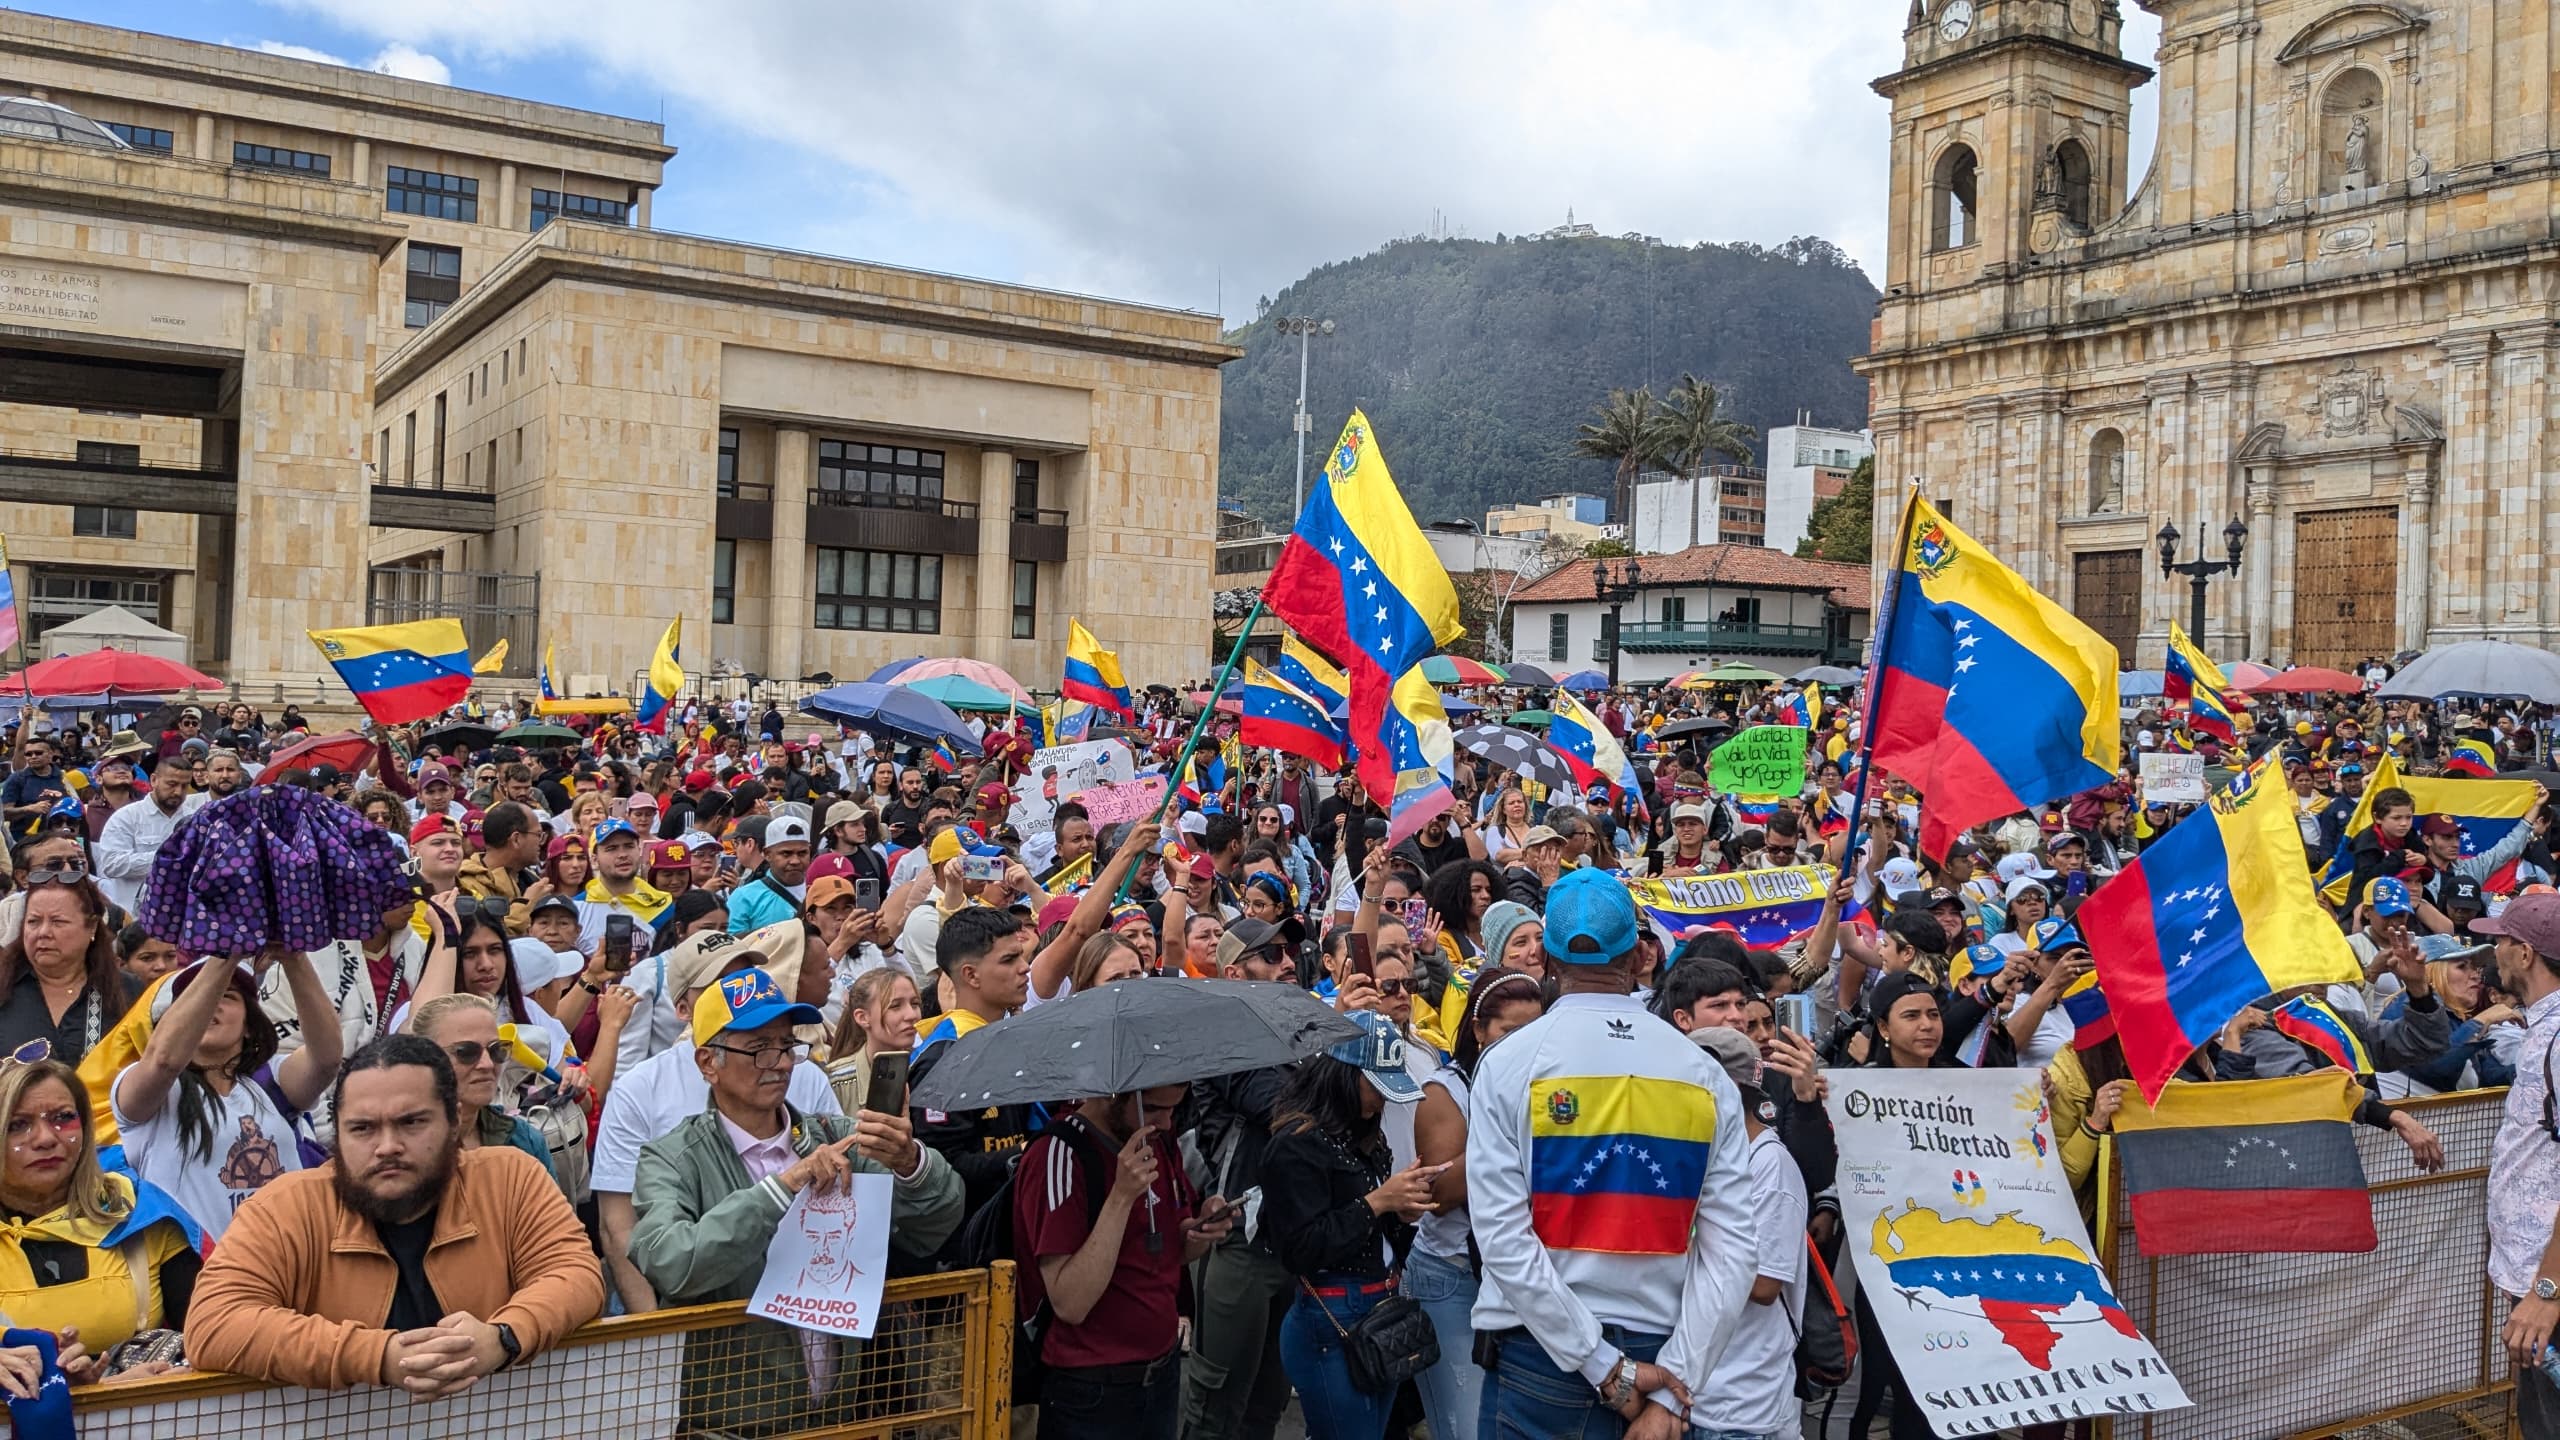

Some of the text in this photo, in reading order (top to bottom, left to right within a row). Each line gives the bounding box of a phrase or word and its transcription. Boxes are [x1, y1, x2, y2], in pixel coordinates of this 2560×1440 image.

[34, 271, 56, 283] LAS
[62, 275, 100, 288] ARMAS
[14, 286, 99, 304] INDEPENDENCIA
[48, 306, 98, 321] LIBERTAD
[1663, 878, 1745, 909] Mano
[1747, 870, 1813, 901] tengo
[390, 967, 403, 991] KARL
[1607, 1032, 1635, 1041] adidas
[1844, 1089, 1975, 1127] Operación
[1903, 1122, 2012, 1159] Libertad
[764, 1303, 860, 1330] DICTADOR
[774, 1294, 857, 1315] MADURO
[1925, 1357, 2133, 1411] SOLICITAMOS
